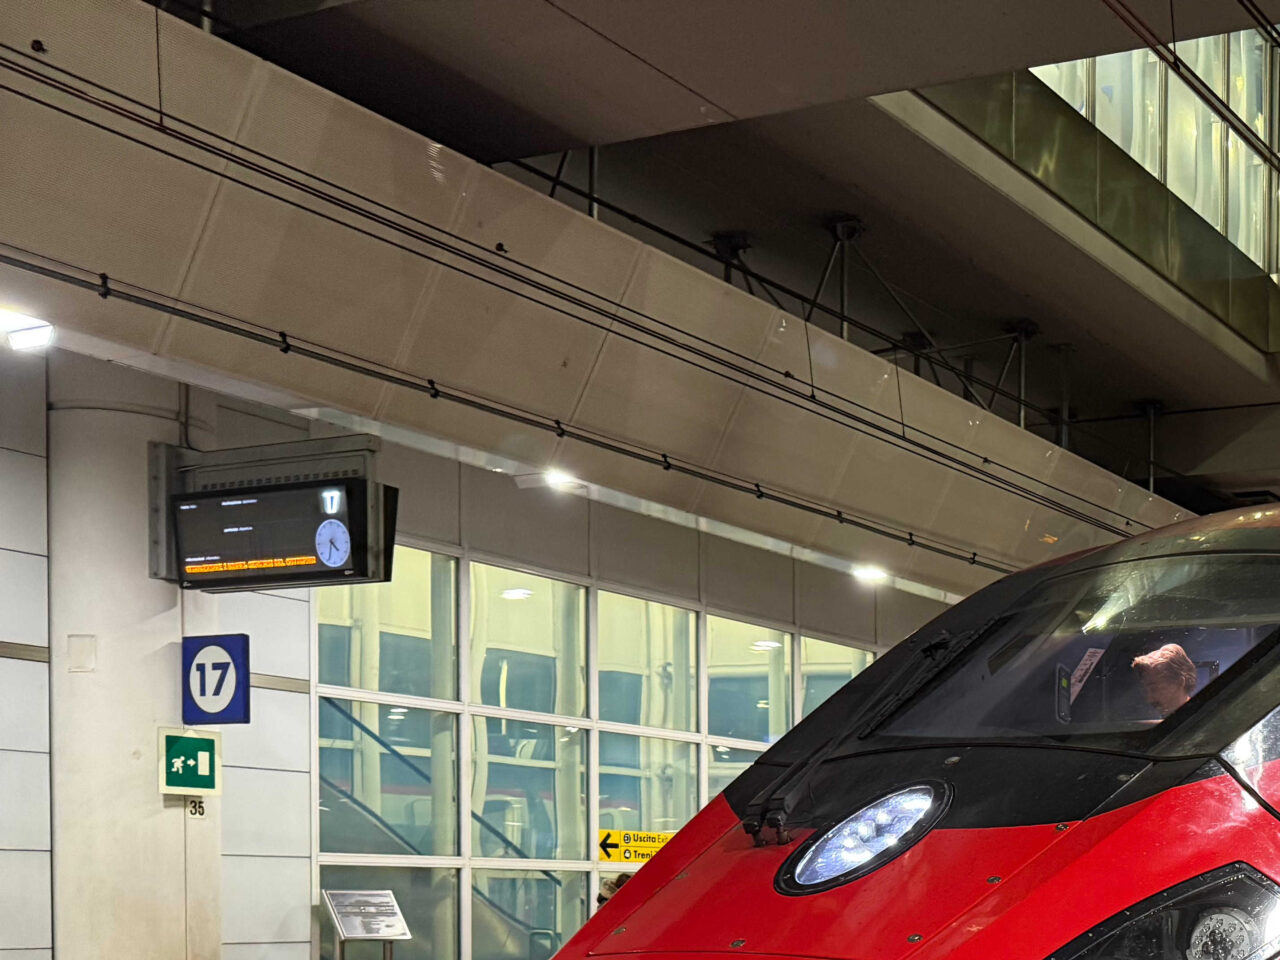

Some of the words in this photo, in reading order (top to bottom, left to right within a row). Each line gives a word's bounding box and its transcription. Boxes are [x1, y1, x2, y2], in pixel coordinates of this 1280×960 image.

[195, 661, 232, 698] 17
[189, 800, 206, 817] 35
[633, 833, 657, 843] Uscita
